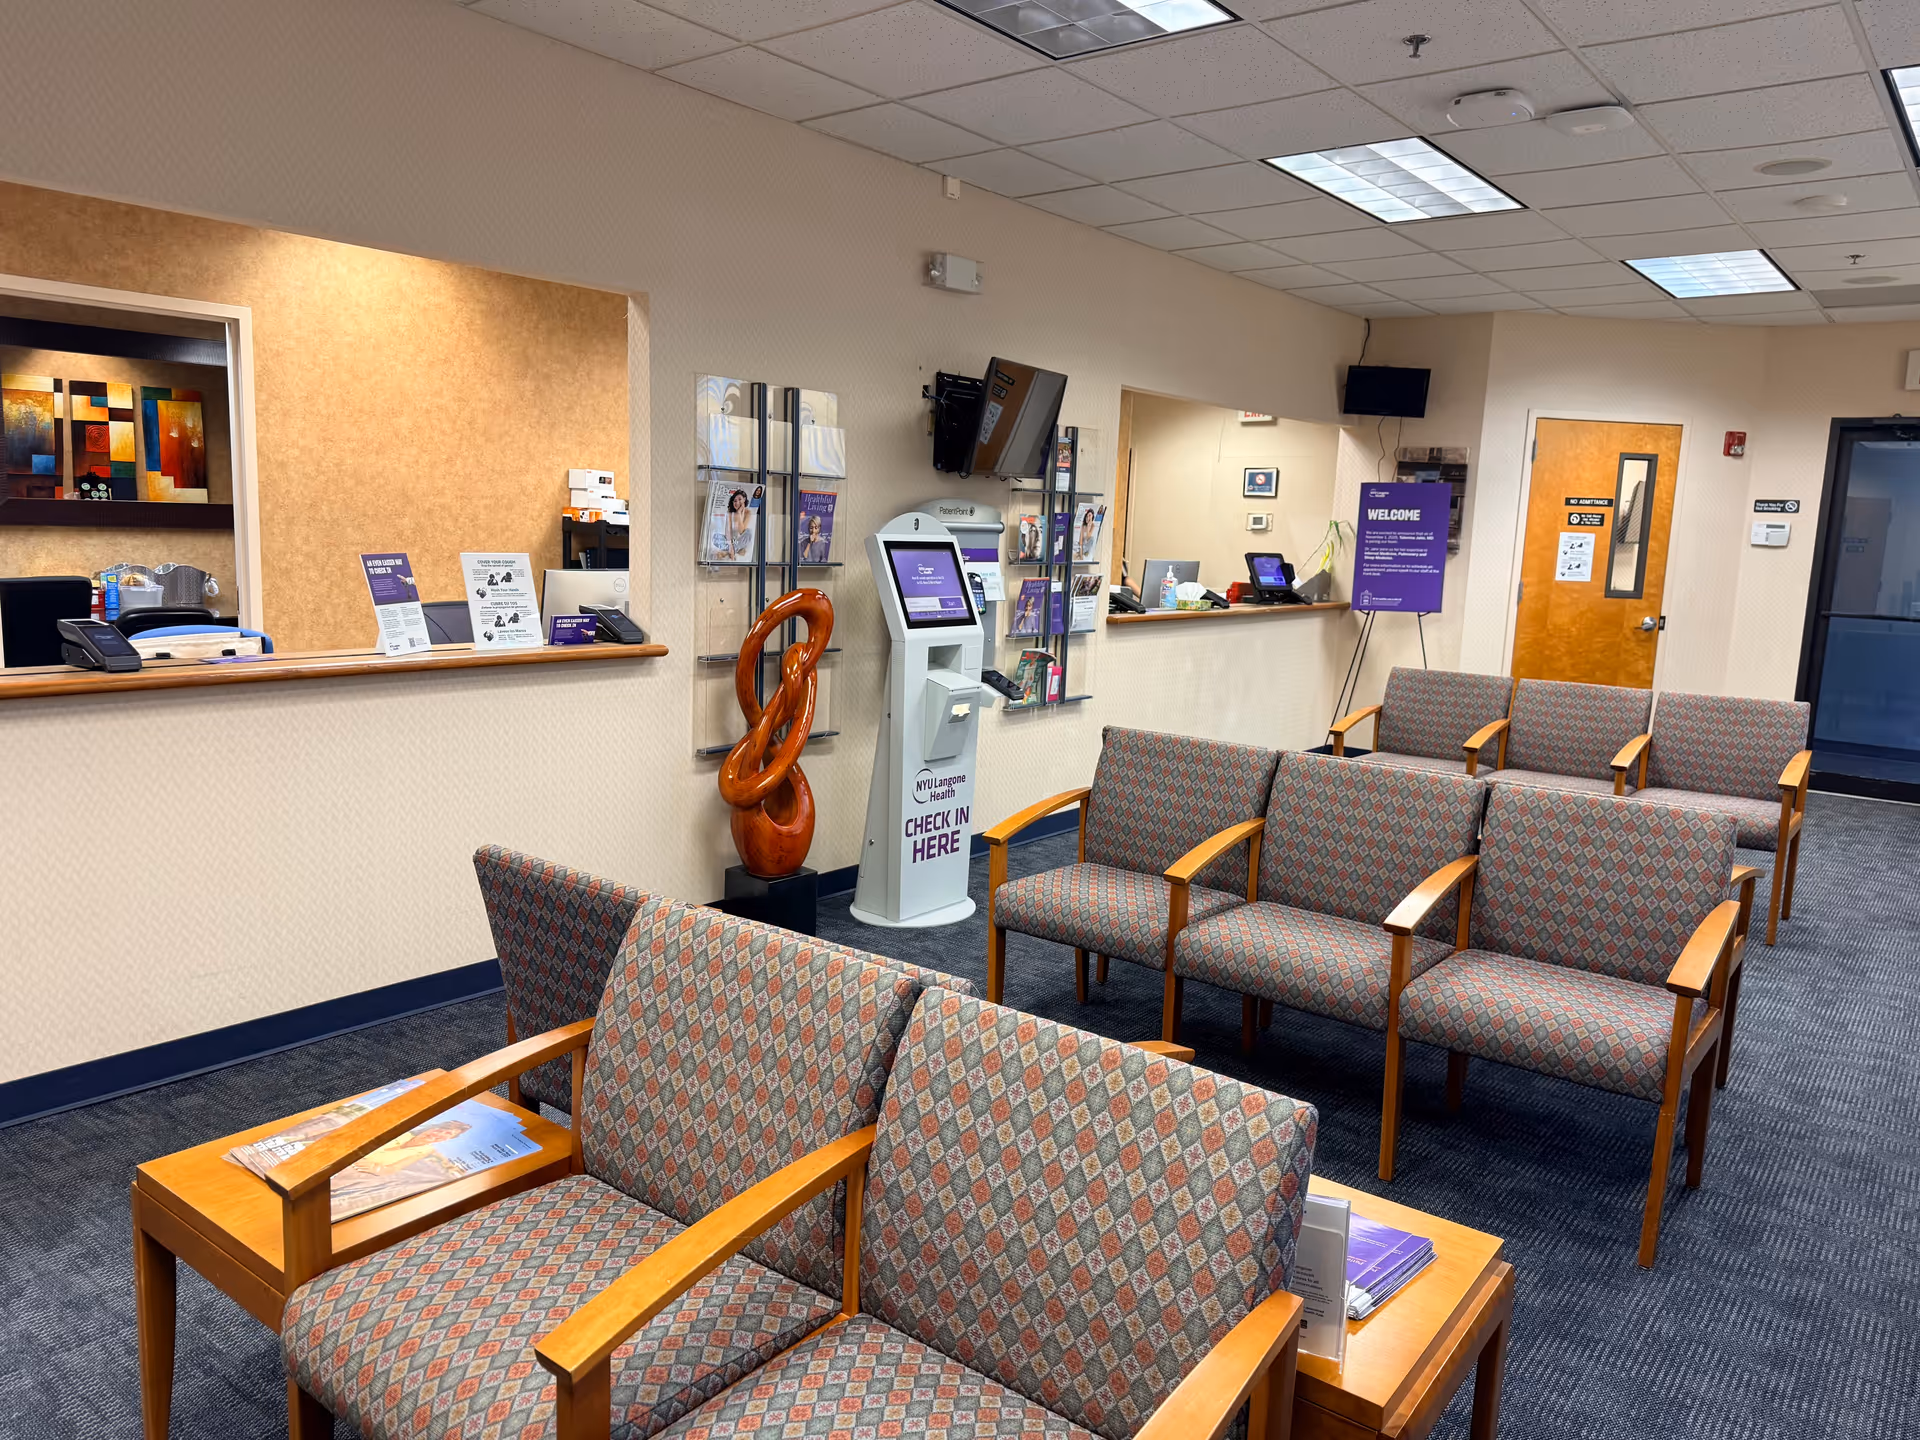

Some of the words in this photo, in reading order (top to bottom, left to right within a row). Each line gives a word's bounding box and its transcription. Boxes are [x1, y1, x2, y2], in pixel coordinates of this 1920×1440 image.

[808, 502, 827, 513] Living
[940, 506, 968, 515] PatientPoint
[1368, 509, 1420, 521] WELCOME
[916, 778, 934, 792] NYU
[934, 774, 966, 788] Langone
[930, 787, 955, 802] Health
[905, 810, 951, 837] CHECK
[955, 806, 969, 826] IN
[912, 830, 960, 863] HERE
